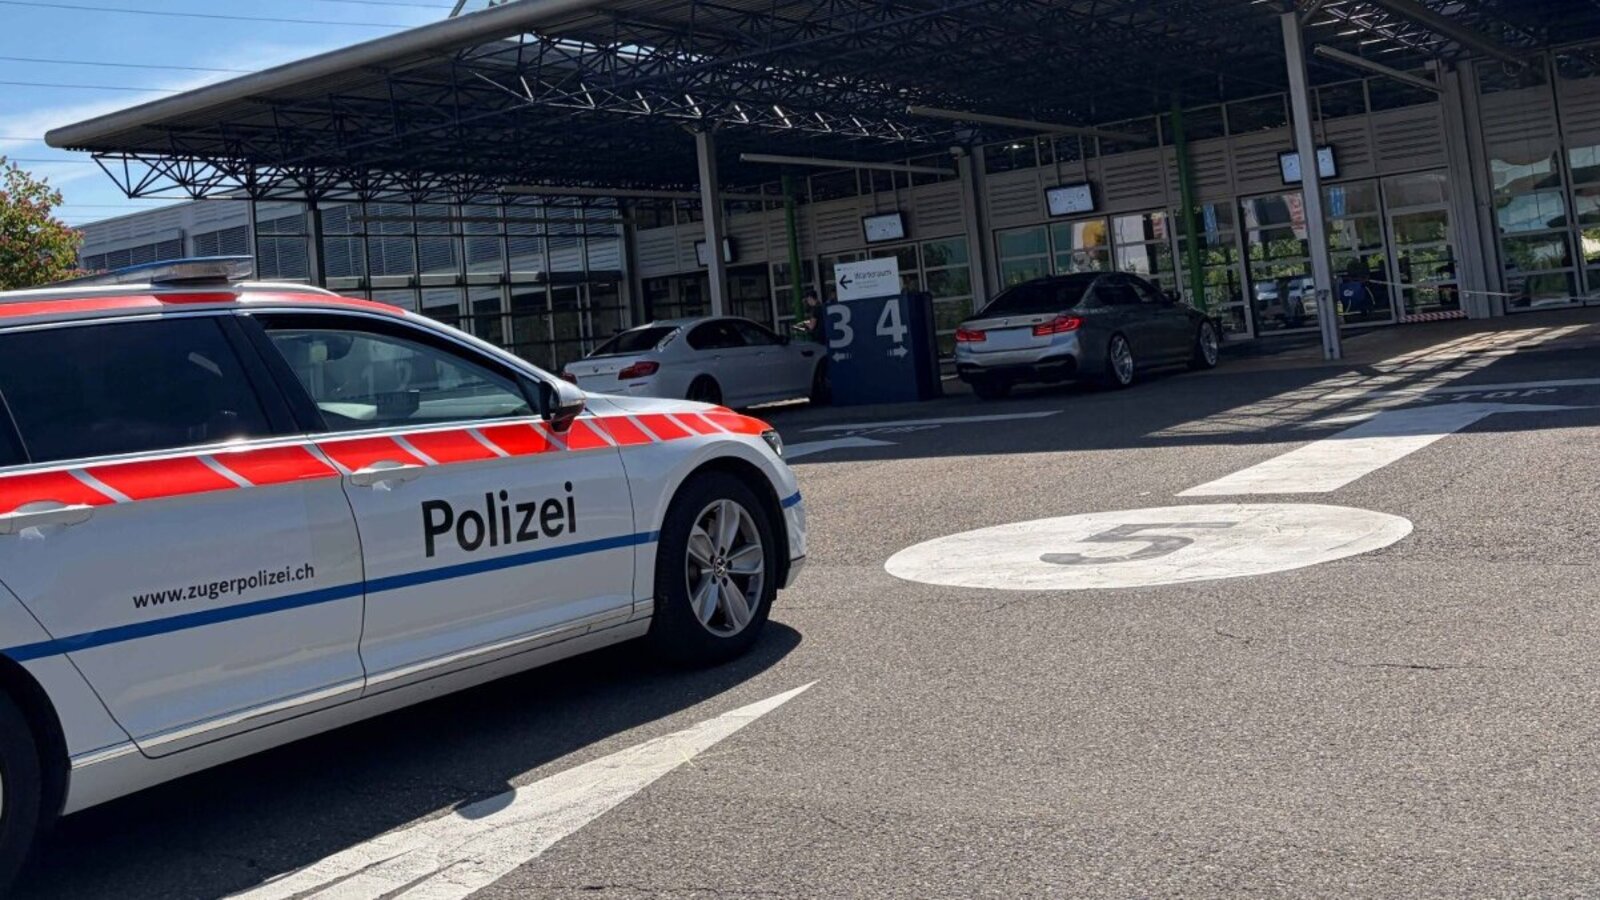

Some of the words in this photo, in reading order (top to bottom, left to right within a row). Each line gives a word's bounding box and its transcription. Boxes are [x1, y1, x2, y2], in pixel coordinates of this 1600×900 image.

[826, 304, 854, 349] 3
[876, 299, 907, 343] 4
[421, 481, 576, 557] Polizei
[1039, 521, 1240, 565] 5
[133, 563, 315, 608] www.zugerpolizei.ch
